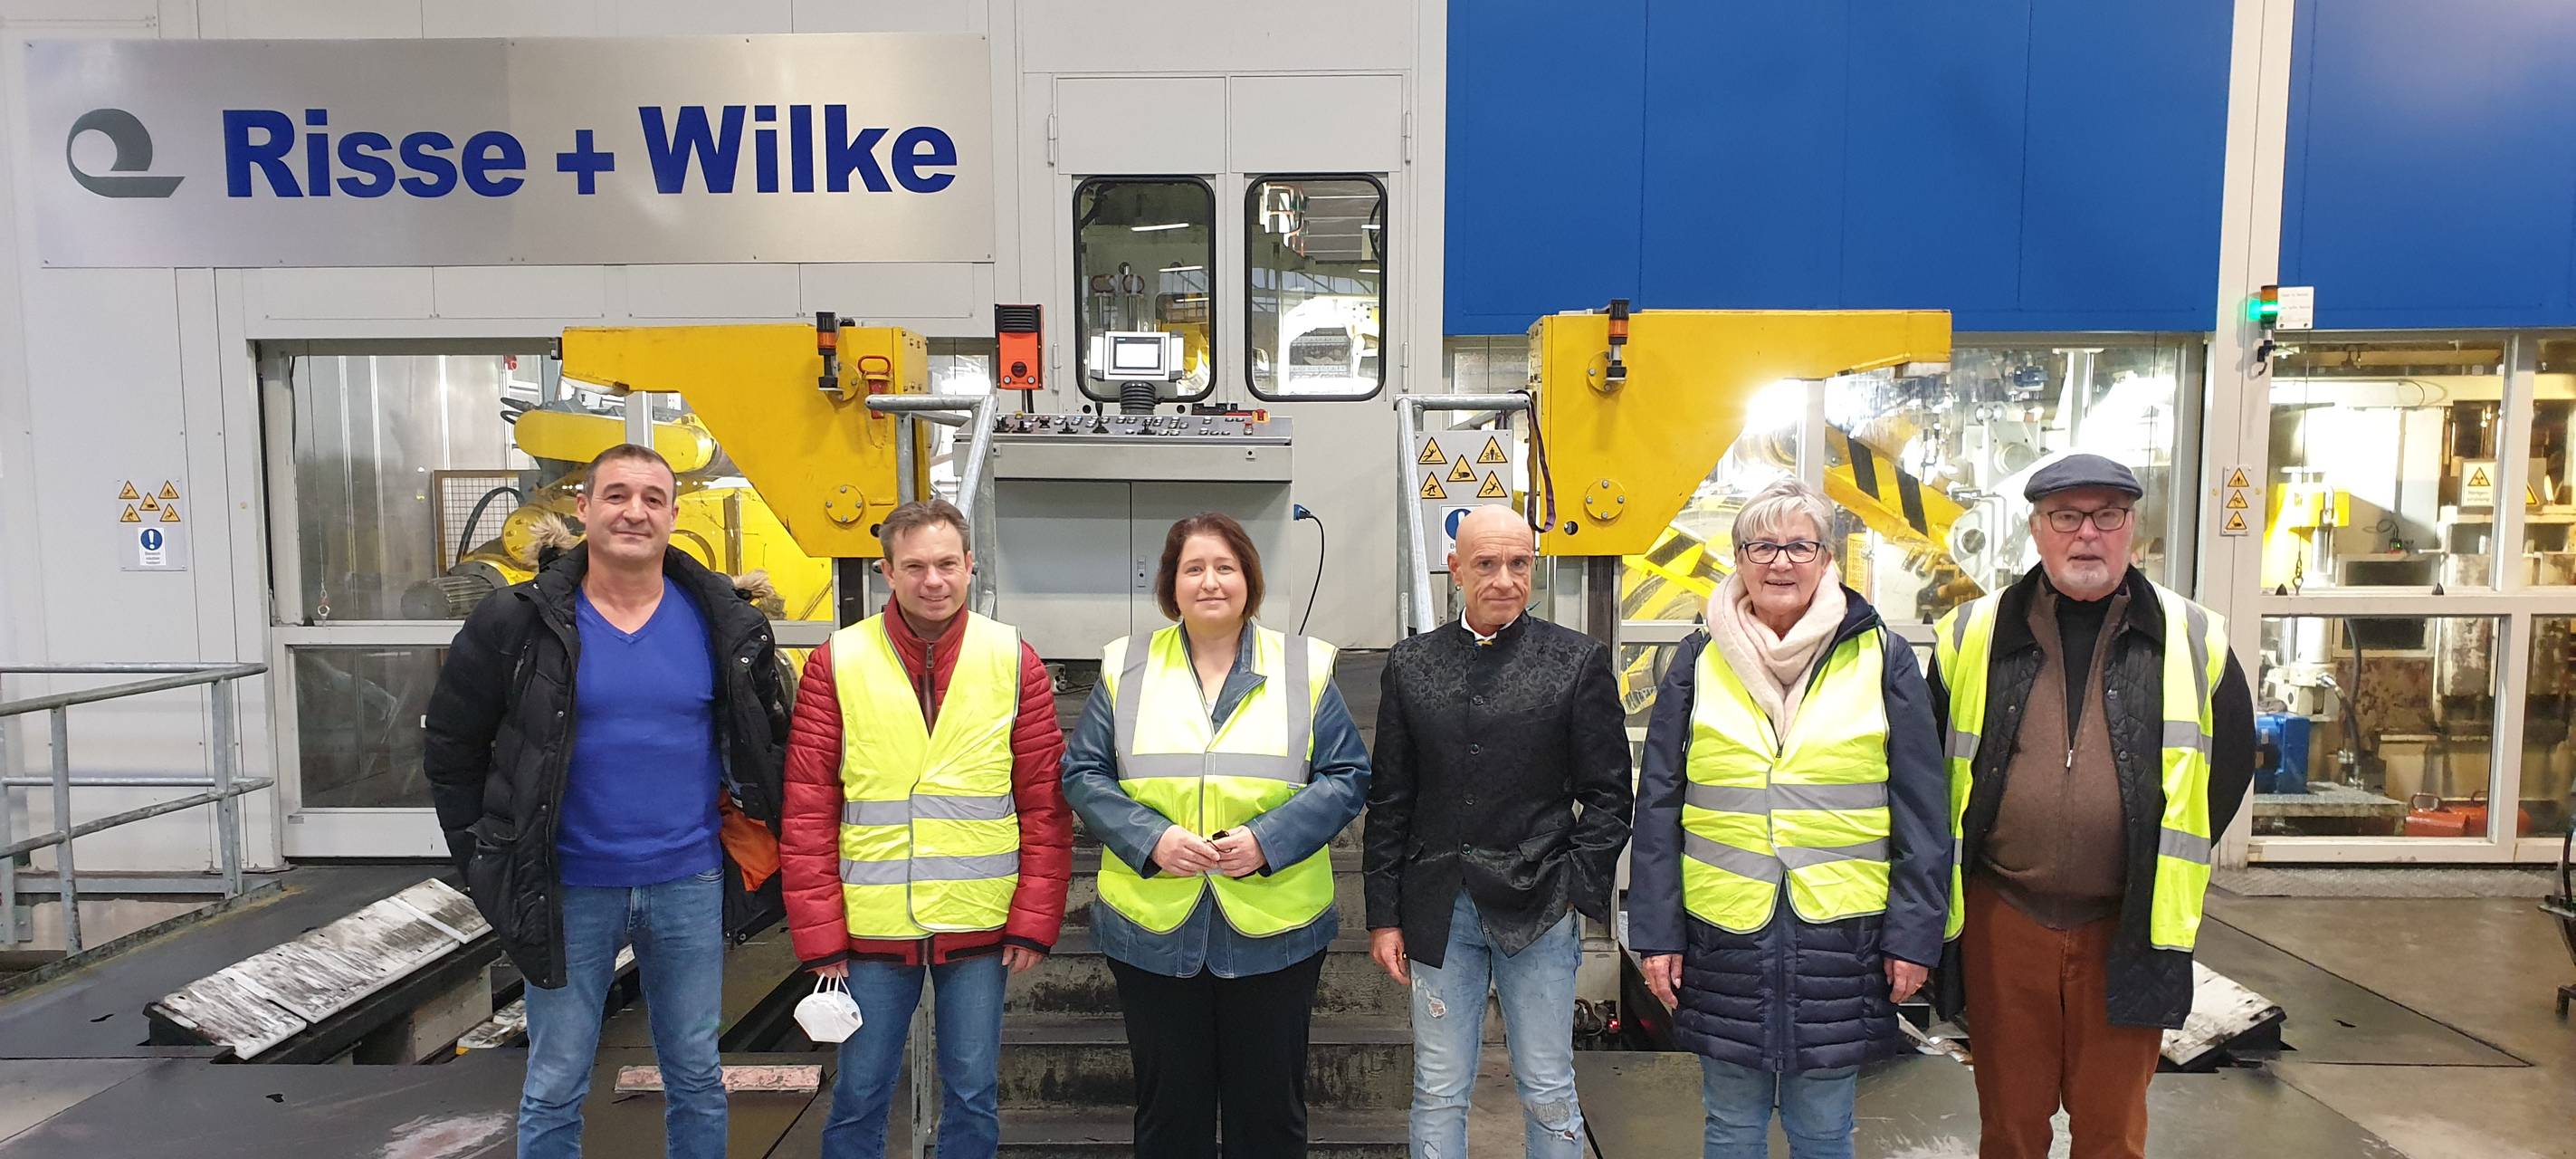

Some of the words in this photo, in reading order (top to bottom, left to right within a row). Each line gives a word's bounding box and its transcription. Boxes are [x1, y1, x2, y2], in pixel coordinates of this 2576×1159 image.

[223, 109, 526, 198] Risse
[557, 129, 615, 195] +
[639, 104, 958, 194] Wilke
